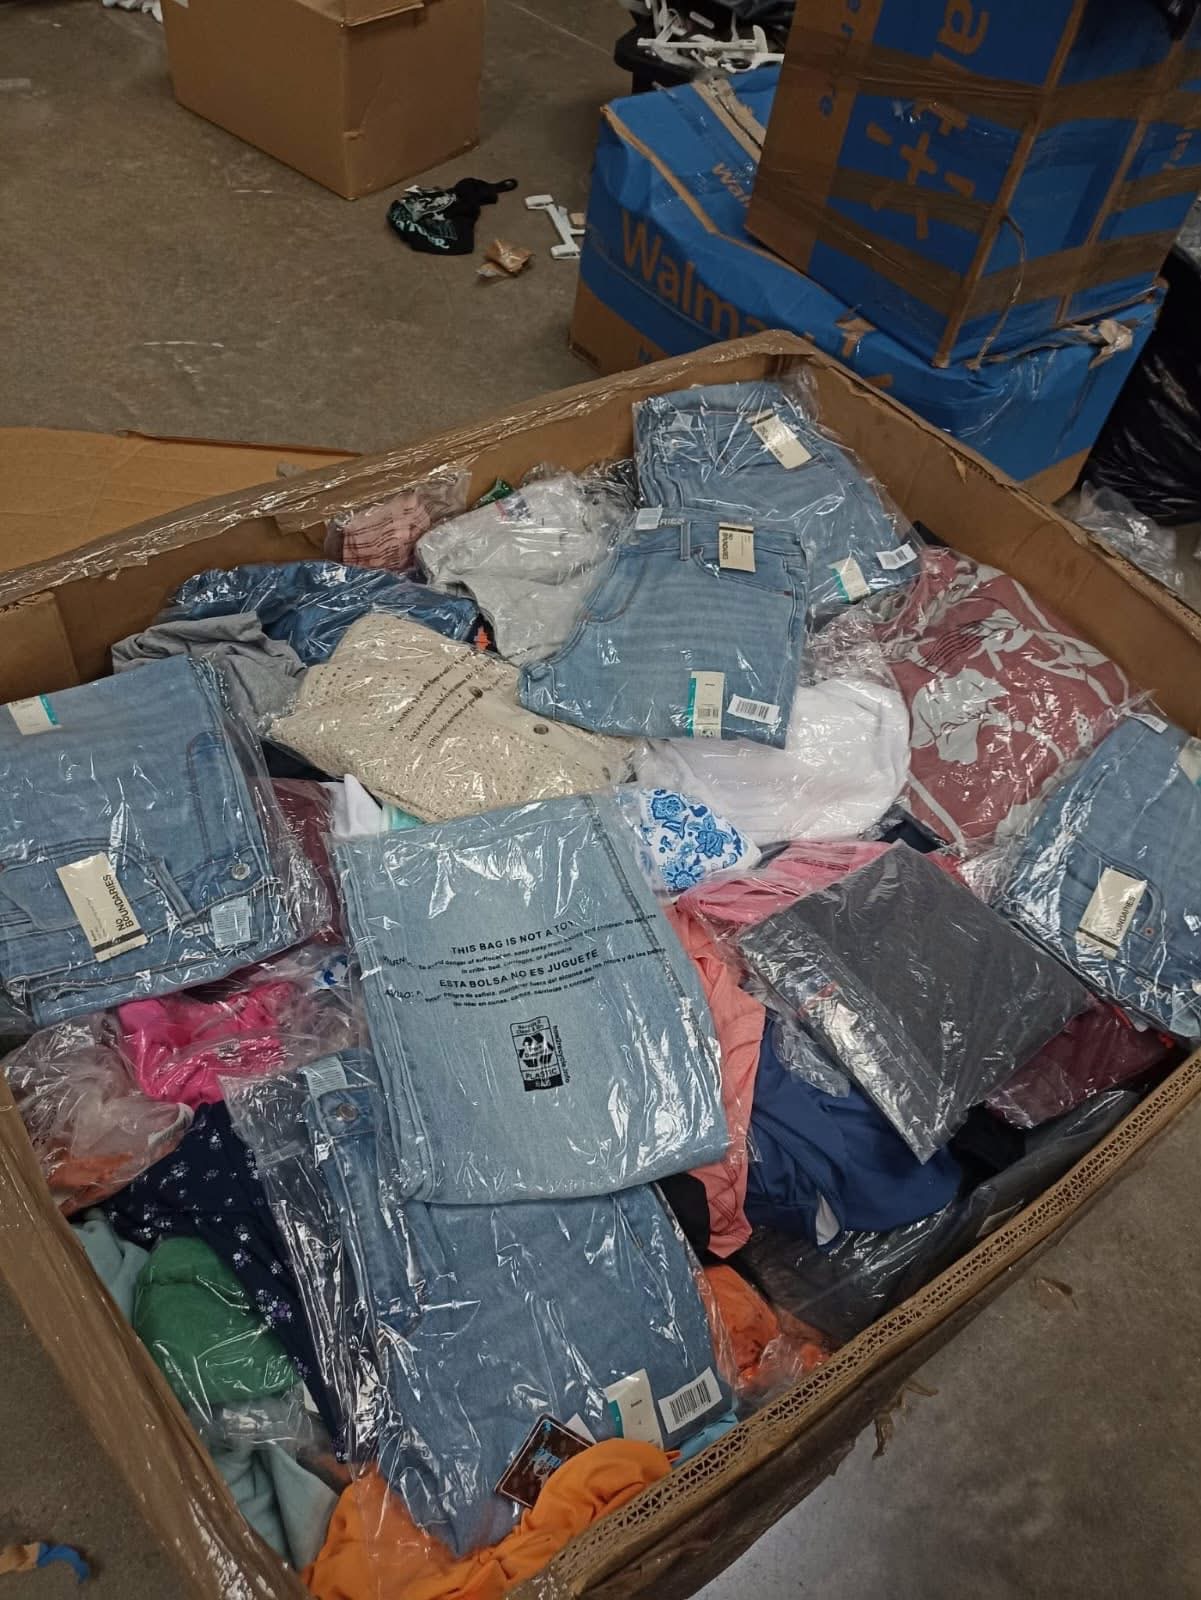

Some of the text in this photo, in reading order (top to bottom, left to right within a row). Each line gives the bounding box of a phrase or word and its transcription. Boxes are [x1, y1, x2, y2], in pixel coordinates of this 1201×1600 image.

[102, 873, 135, 930] BOUNDARIES
[116, 918, 126, 932] NO
[451, 944, 477, 955] THIS
[479, 940, 503, 951] BAG
[506, 937, 517, 946] IS
[520, 931, 542, 943] NOT
[439, 948, 600, 989] ESTA BOLSA NO ES JUGUETE
